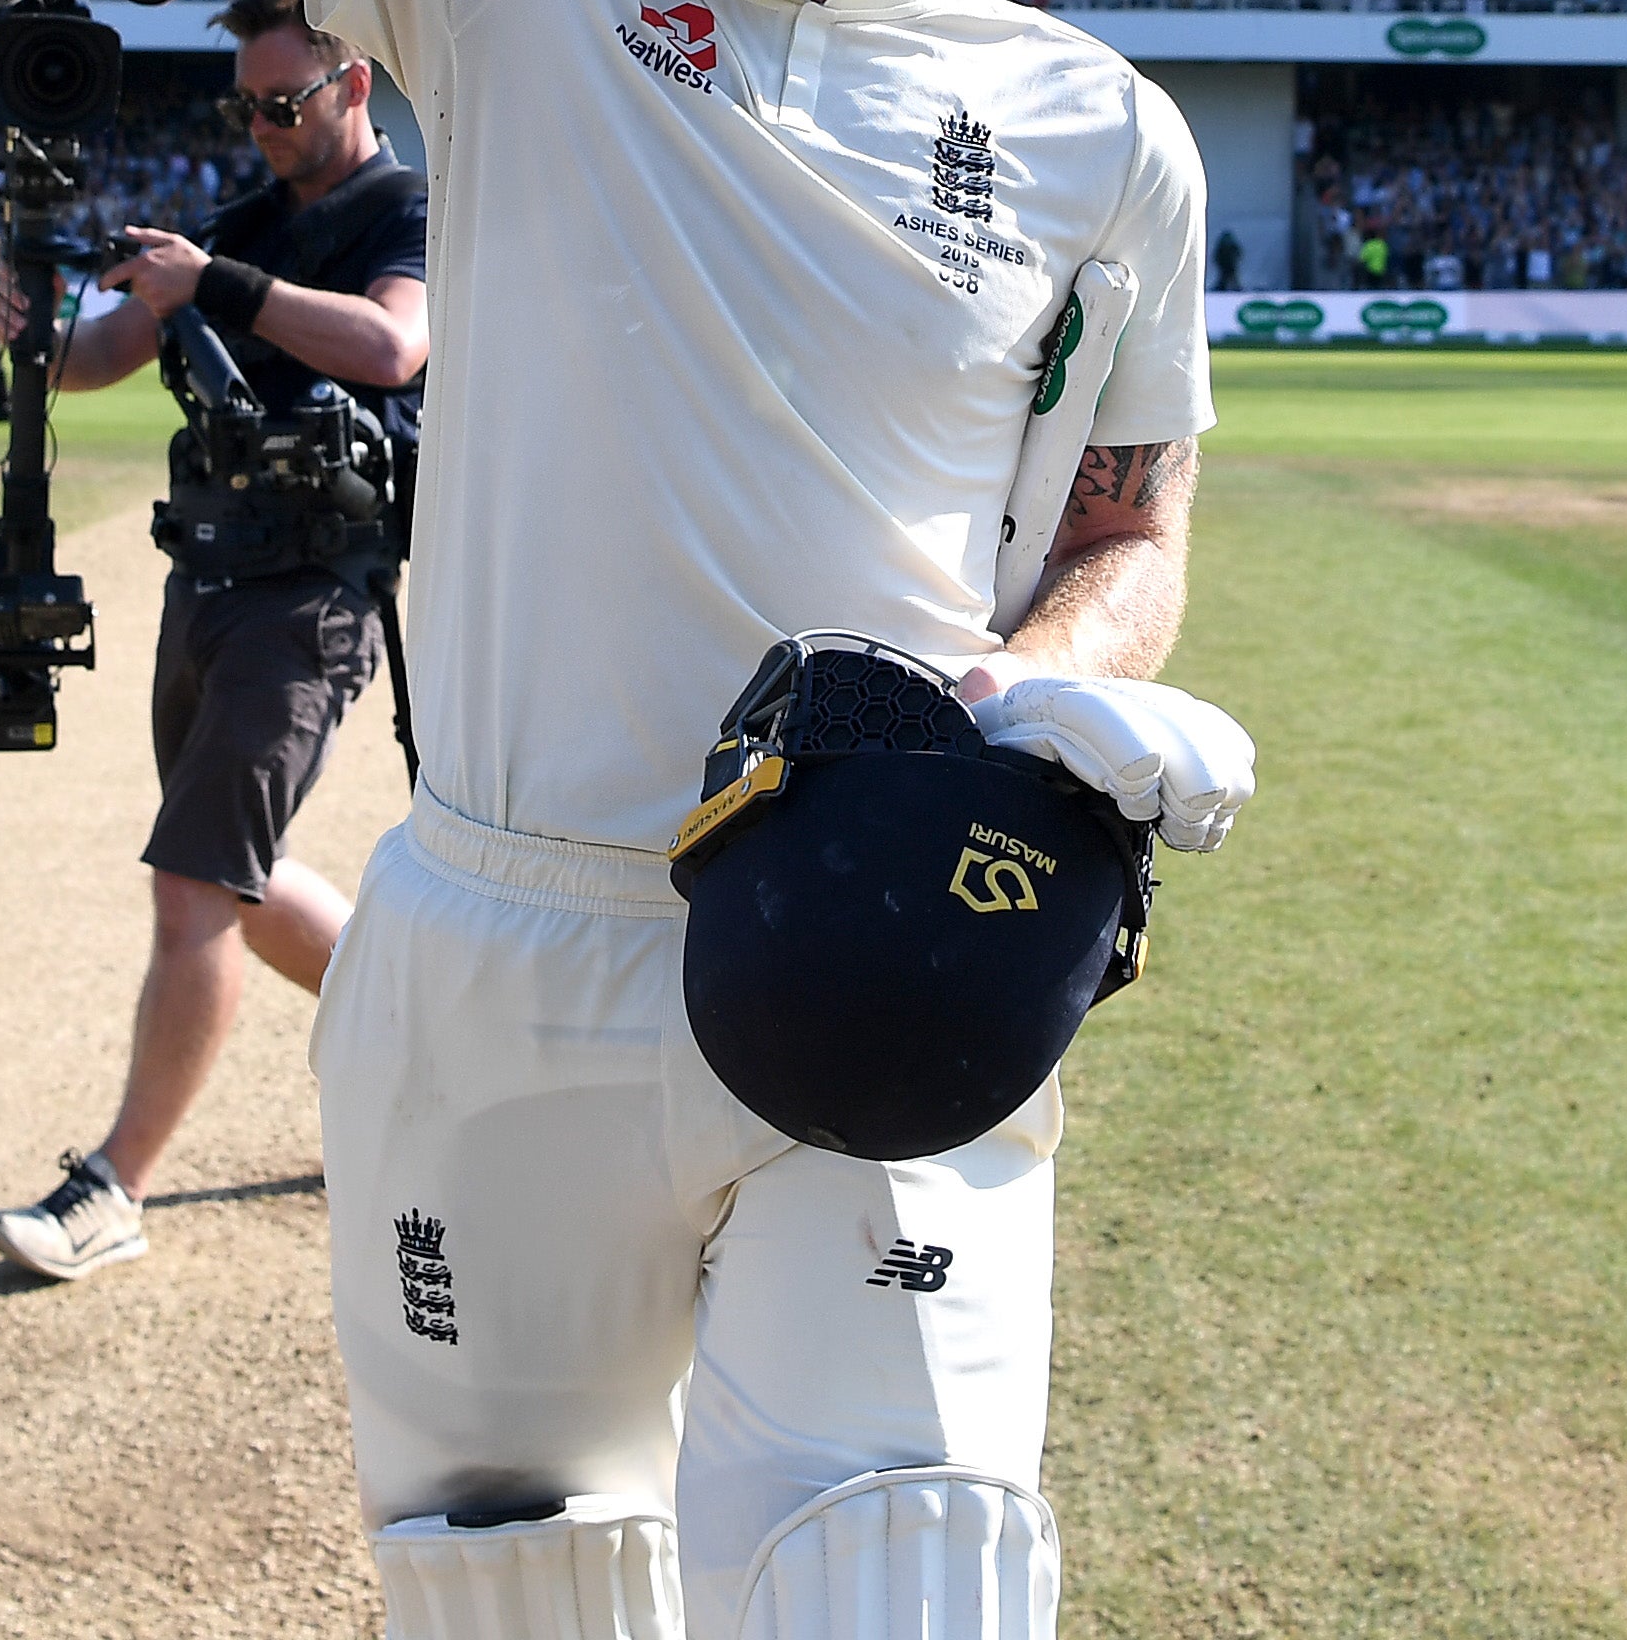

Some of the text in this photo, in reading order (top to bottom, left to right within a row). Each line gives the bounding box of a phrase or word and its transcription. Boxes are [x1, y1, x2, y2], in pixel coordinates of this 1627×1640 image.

[615, 23, 713, 95] NatWest
[893, 213, 1025, 266] ASHES SERIES
[969, 822, 1057, 875] MASURI
